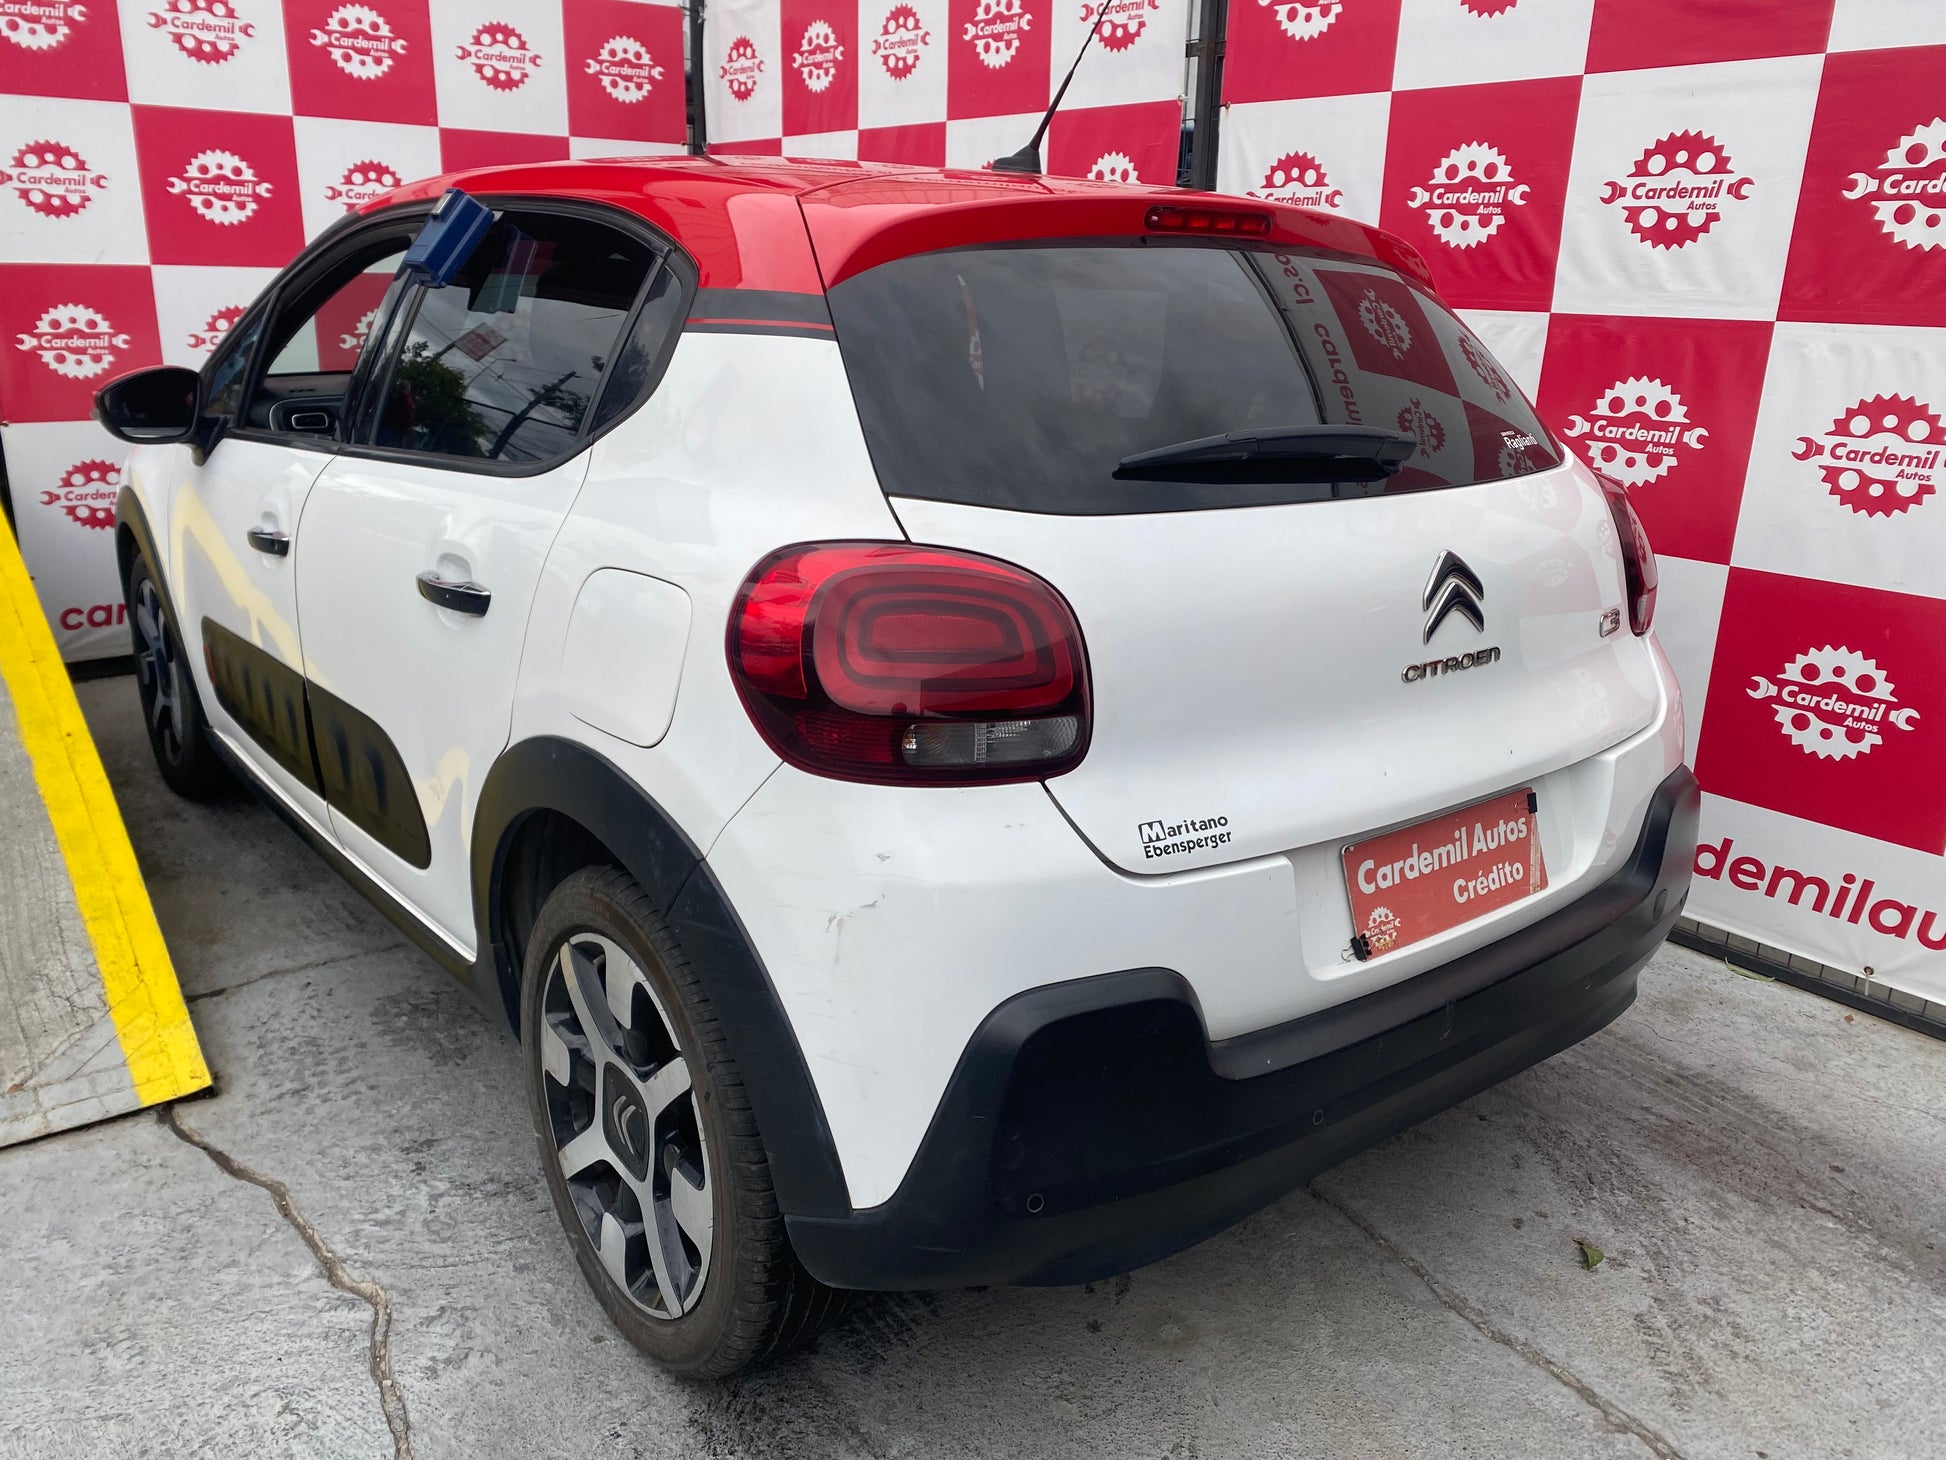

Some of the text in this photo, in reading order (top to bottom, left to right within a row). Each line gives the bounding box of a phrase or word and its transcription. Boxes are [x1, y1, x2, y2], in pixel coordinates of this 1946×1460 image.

[0, 1, 64, 17] ardemil
[171, 17, 235, 34] Cardemil
[978, 17, 1019, 35] Cardemil
[330, 33, 389, 50] Cardemil
[883, 35, 918, 51] Cardemil
[474, 49, 526, 65] Cardemil
[602, 63, 648, 77] Cardemil
[17, 172, 86, 187] Cardemil
[1884, 172, 1946, 195] Card
[189, 182, 252, 195] Cardemil
[1432, 186, 1504, 205] Cardemil
[1631, 179, 1724, 200] Cardemil
[1477, 204, 1501, 215] Autos
[1687, 201, 1717, 211] Autos
[41, 334, 109, 348] Cardemil
[1593, 420, 1680, 444] Cardemil
[1645, 443, 1674, 455] Autos
[1830, 442, 1941, 469] Cardemil
[1895, 468, 1933, 481] Autos
[1600, 608, 1621, 638] C3
[1781, 685, 1887, 722] Cardemil
[1843, 717, 1880, 733] Autos
[1138, 816, 1228, 844] Maritano
[1144, 832, 1231, 859] Ebensperger
[1357, 827, 1469, 895] Cardemil
[1471, 816, 1528, 857] Autos
[1453, 861, 1524, 904] Crédito
